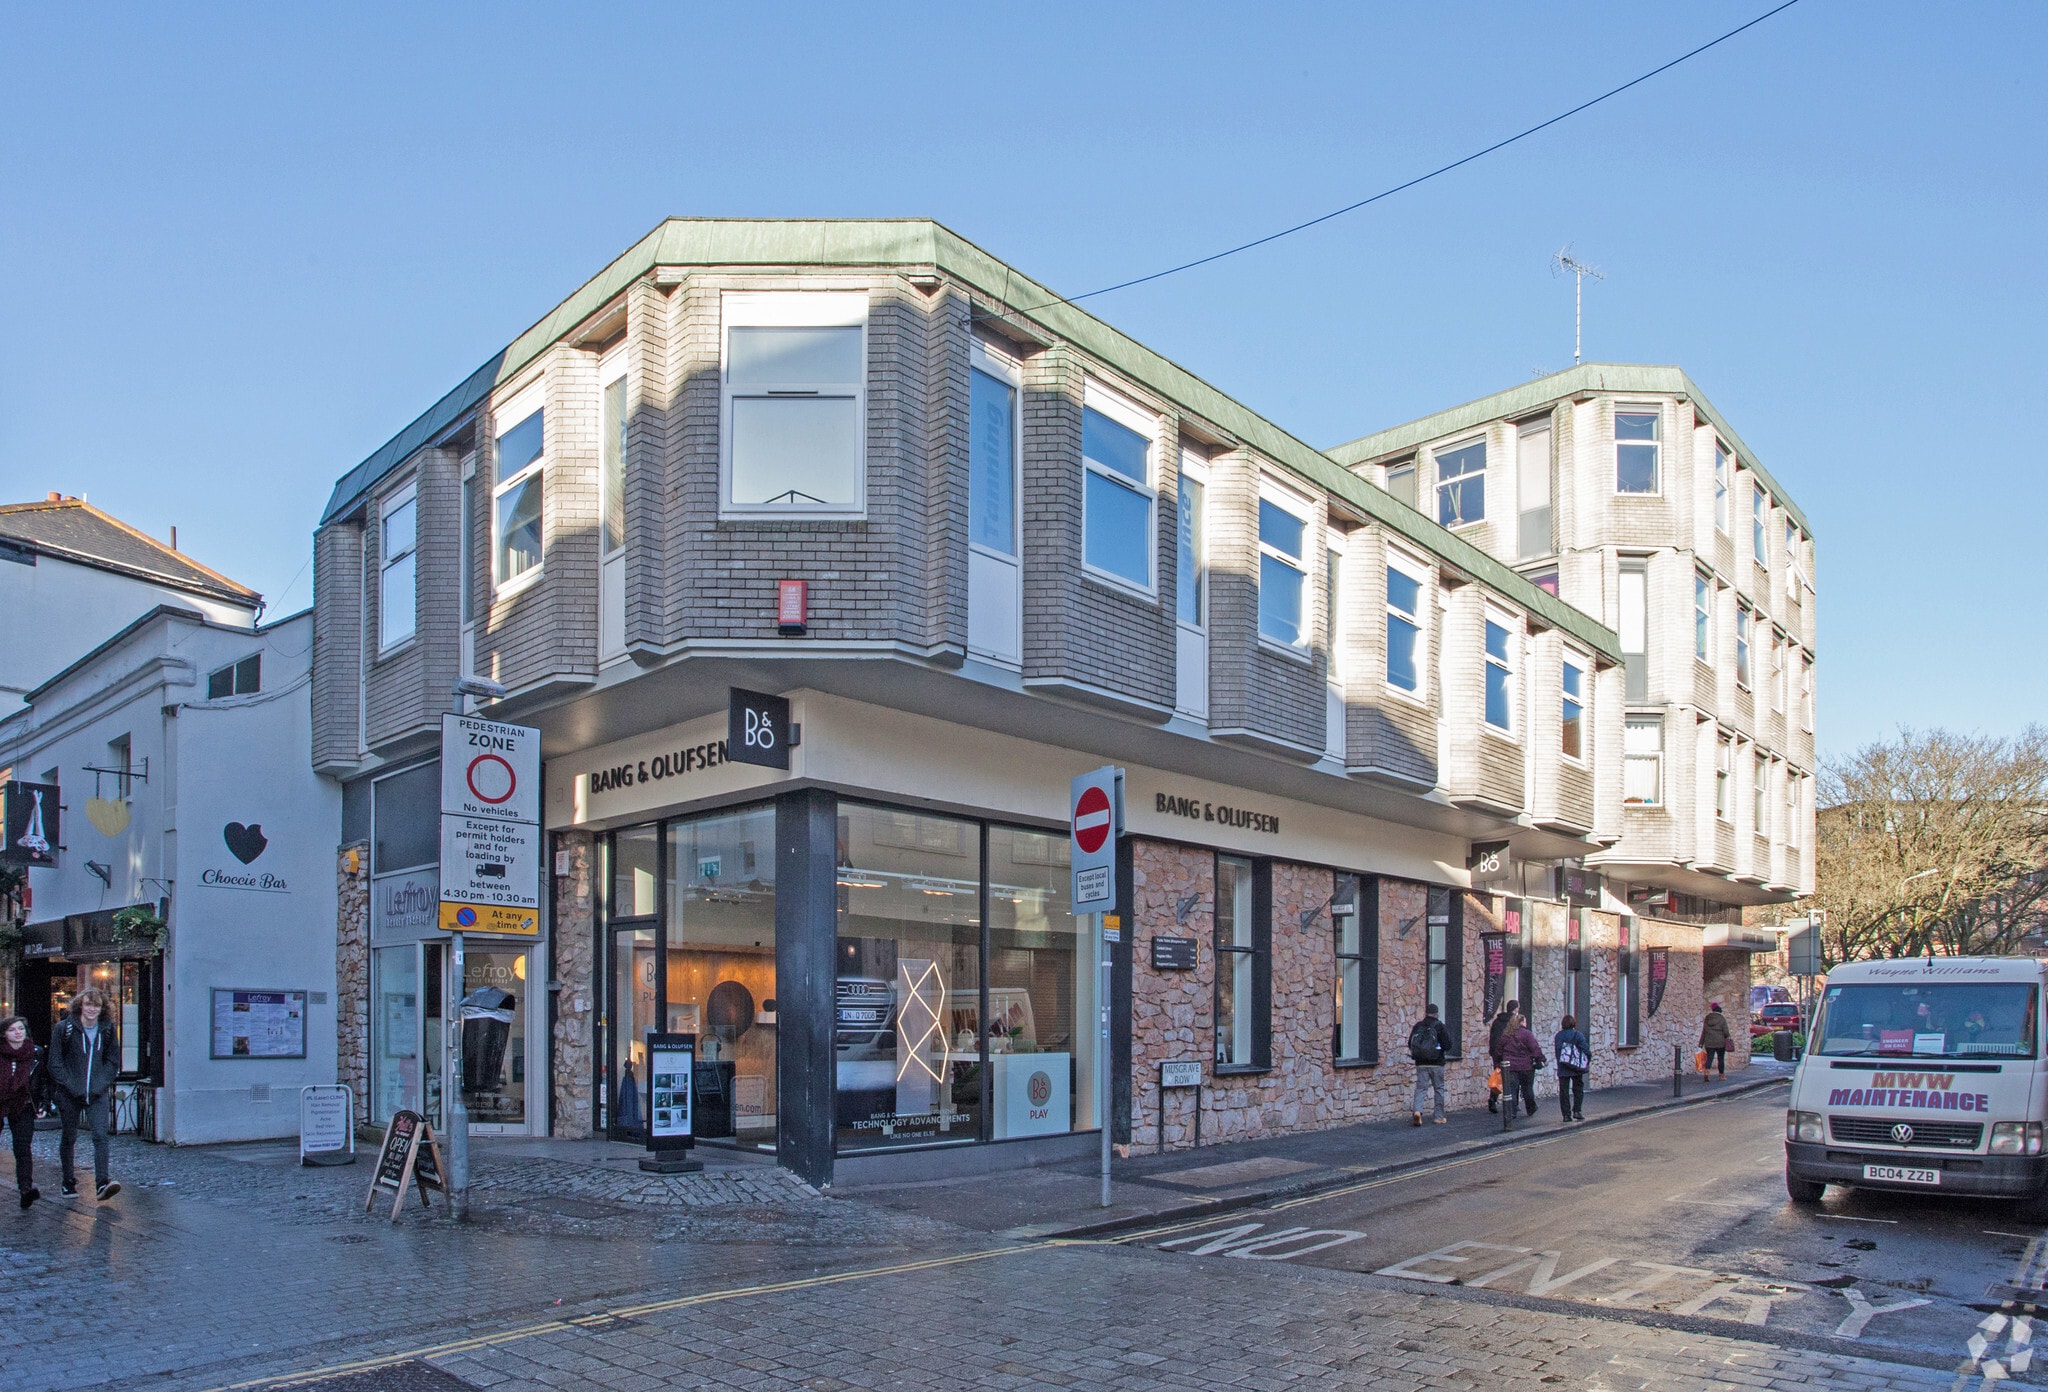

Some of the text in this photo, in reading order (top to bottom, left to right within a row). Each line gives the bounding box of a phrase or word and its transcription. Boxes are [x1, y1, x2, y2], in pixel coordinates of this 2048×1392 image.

[982, 401, 1003, 538] Tanning
[460, 720, 525, 737] PEDESTRIAN
[469, 733, 515, 751] ZONE
[591, 738, 730, 793] BANG & OLUFSEN
[464, 803, 518, 817] No vehicles
[1156, 792, 1279, 834] BANG & OLUFSEN
[466, 821, 515, 833] Except for
[456, 831, 525, 844] permit holders
[474, 843, 507, 852] and for
[466, 851, 515, 864] loading by
[202, 869, 287, 889] Choccie Bar
[1078, 872, 1106, 883] Except local
[470, 880, 511, 891] between
[1080, 883, 1094, 891] buses
[444, 889, 468, 898] 4.30
[492, 893, 520, 902] 10.30
[521, 896, 535, 904] am
[1085, 890, 1100, 900] cycles
[492, 910, 523, 920] At any
[497, 921, 517, 929] time
[1488, 939, 1502, 949] THE
[1489, 949, 1504, 975] HAIR
[1653, 952, 1666, 960] THE
[1653, 960, 1666, 980] HAIR
[1869, 967, 2000, 978] Wayne Williams
[1164, 1063, 1200, 1074] MUSGRAVE
[1174, 1075, 1190, 1085] ROW
[1871, 1072, 1955, 1091] MWW
[1828, 1089, 1989, 1113] MAINTENANCE
[1030, 1109, 1049, 1120] PLAY
[852, 1118, 908, 1130] TECHNOLOGY
[389, 1137, 412, 1153] OPEN
[1869, 1166, 1934, 1182] BC04 ZZB
[1158, 1223, 1934, 1339] NO ENTRY
